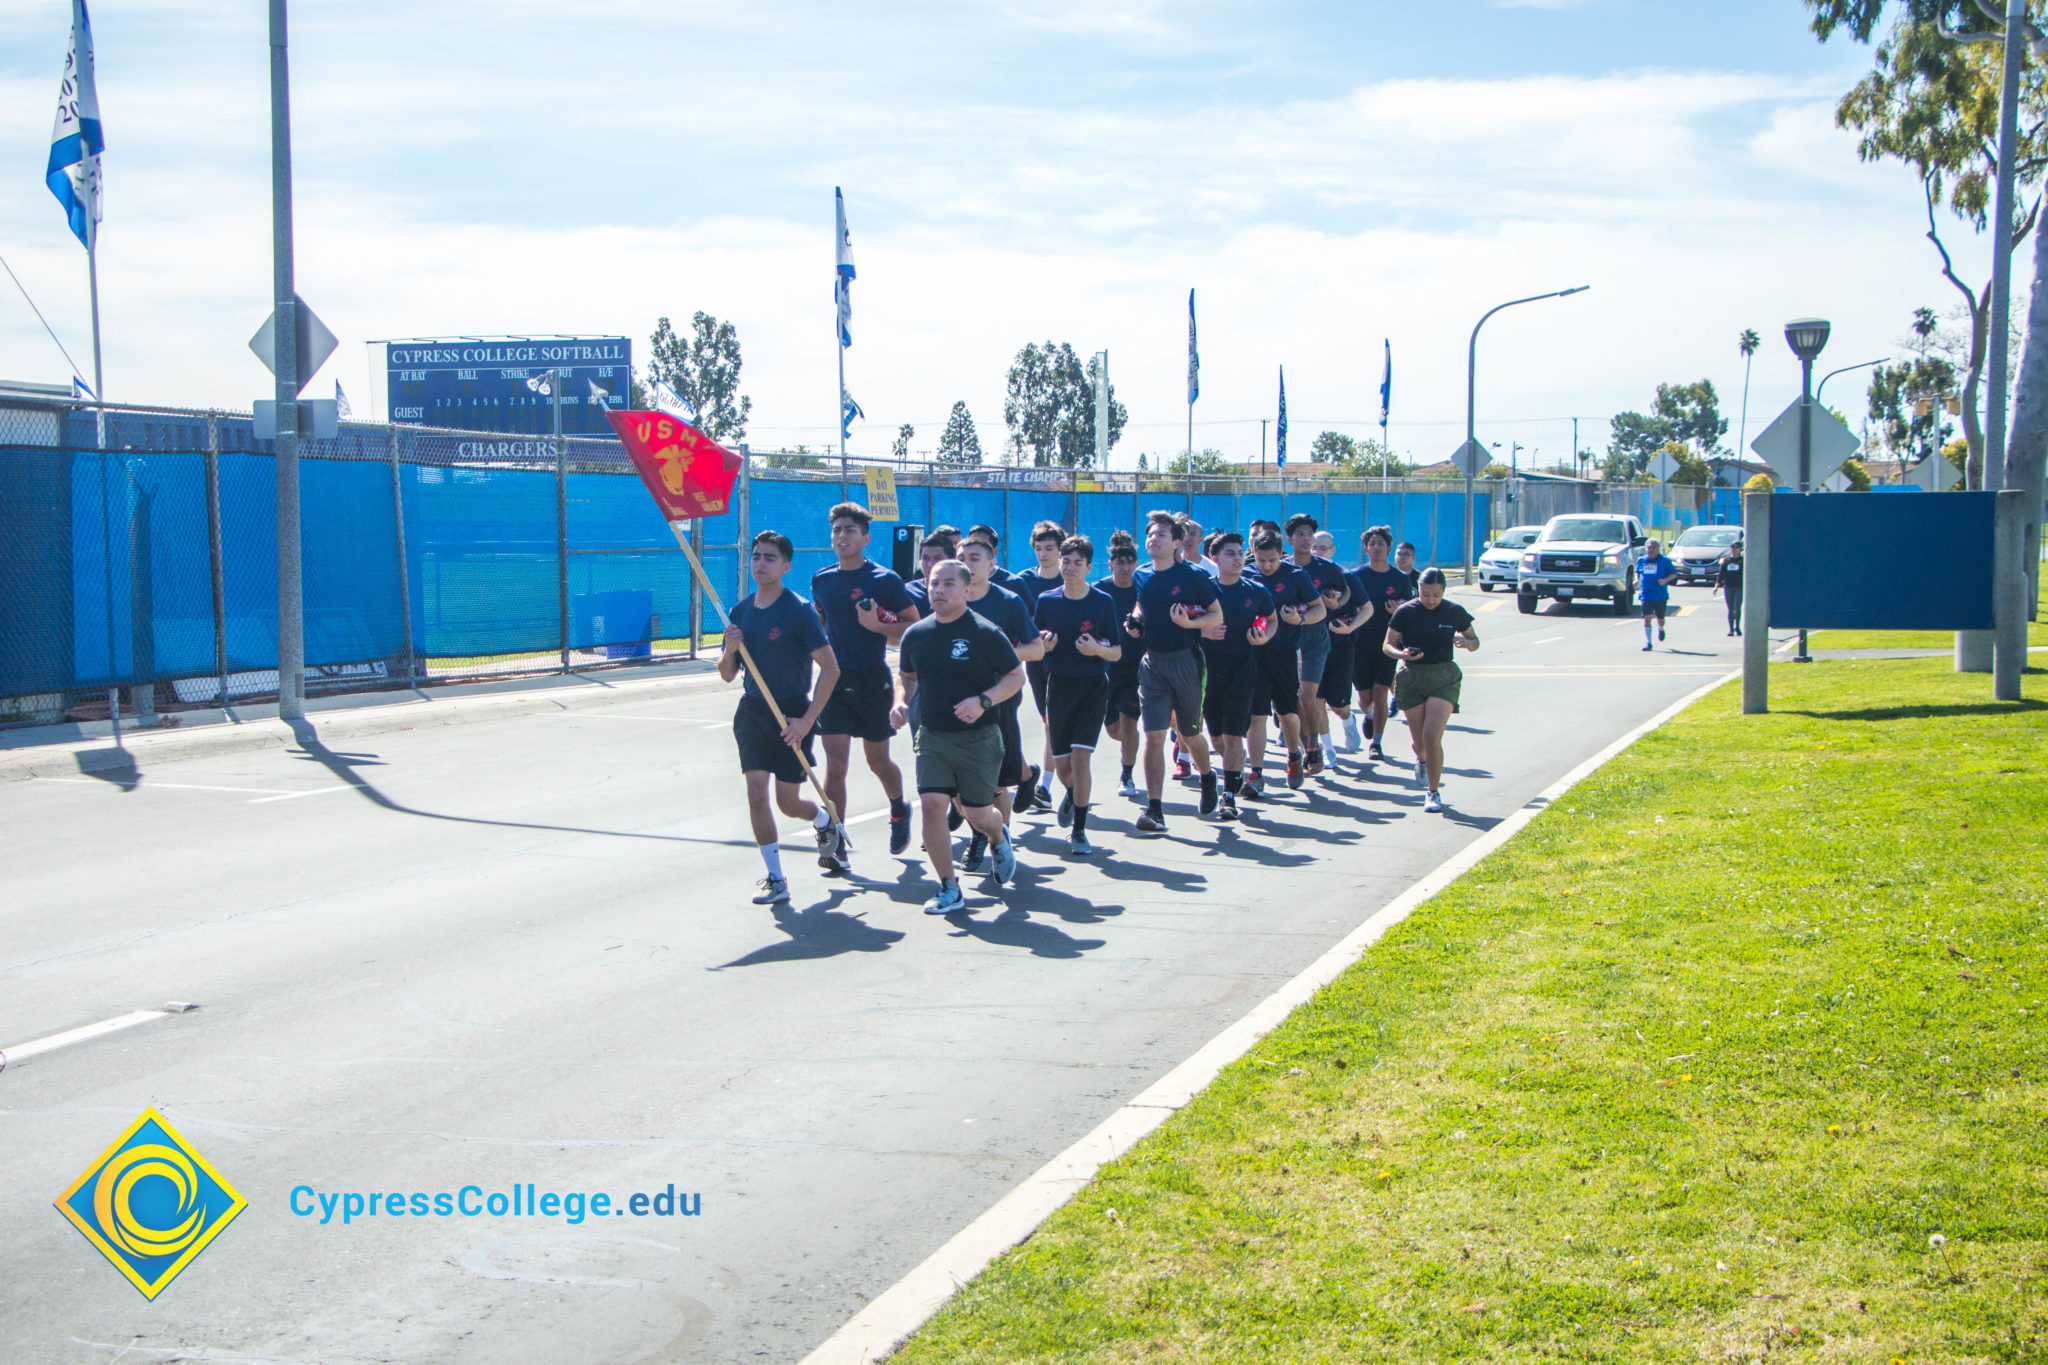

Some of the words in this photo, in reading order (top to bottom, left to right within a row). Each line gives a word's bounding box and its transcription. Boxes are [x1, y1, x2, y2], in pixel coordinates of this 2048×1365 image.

[392, 349, 460, 364] CYPRESS
[463, 347, 538, 362] COLLEGE
[541, 345, 624, 361] SOFTBALL
[400, 371, 410, 381] AT
[411, 371, 427, 381] BAT
[458, 369, 479, 380] BALL
[501, 368, 530, 379] STRIKE
[598, 366, 614, 377] H/E
[446, 398, 452, 407] 2
[457, 398, 462, 407] 3
[472, 397, 477, 406] 4
[483, 397, 488, 406] 5
[494, 397, 499, 406] 6
[520, 397, 525, 406] 8
[531, 397, 536, 406] 9
[546, 396, 554, 405] 10
[609, 396, 623, 404] ERR
[394, 407, 424, 419] GUEST
[459, 442, 557, 457] CHARGERS
[987, 472, 1022, 483] STATE
[1024, 471, 1067, 482] CHAMPS
[876, 480, 887, 490] DAY
[870, 493, 896, 503] PARKING
[871, 506, 897, 516] PERMITS
[899, 528, 908, 541] P
